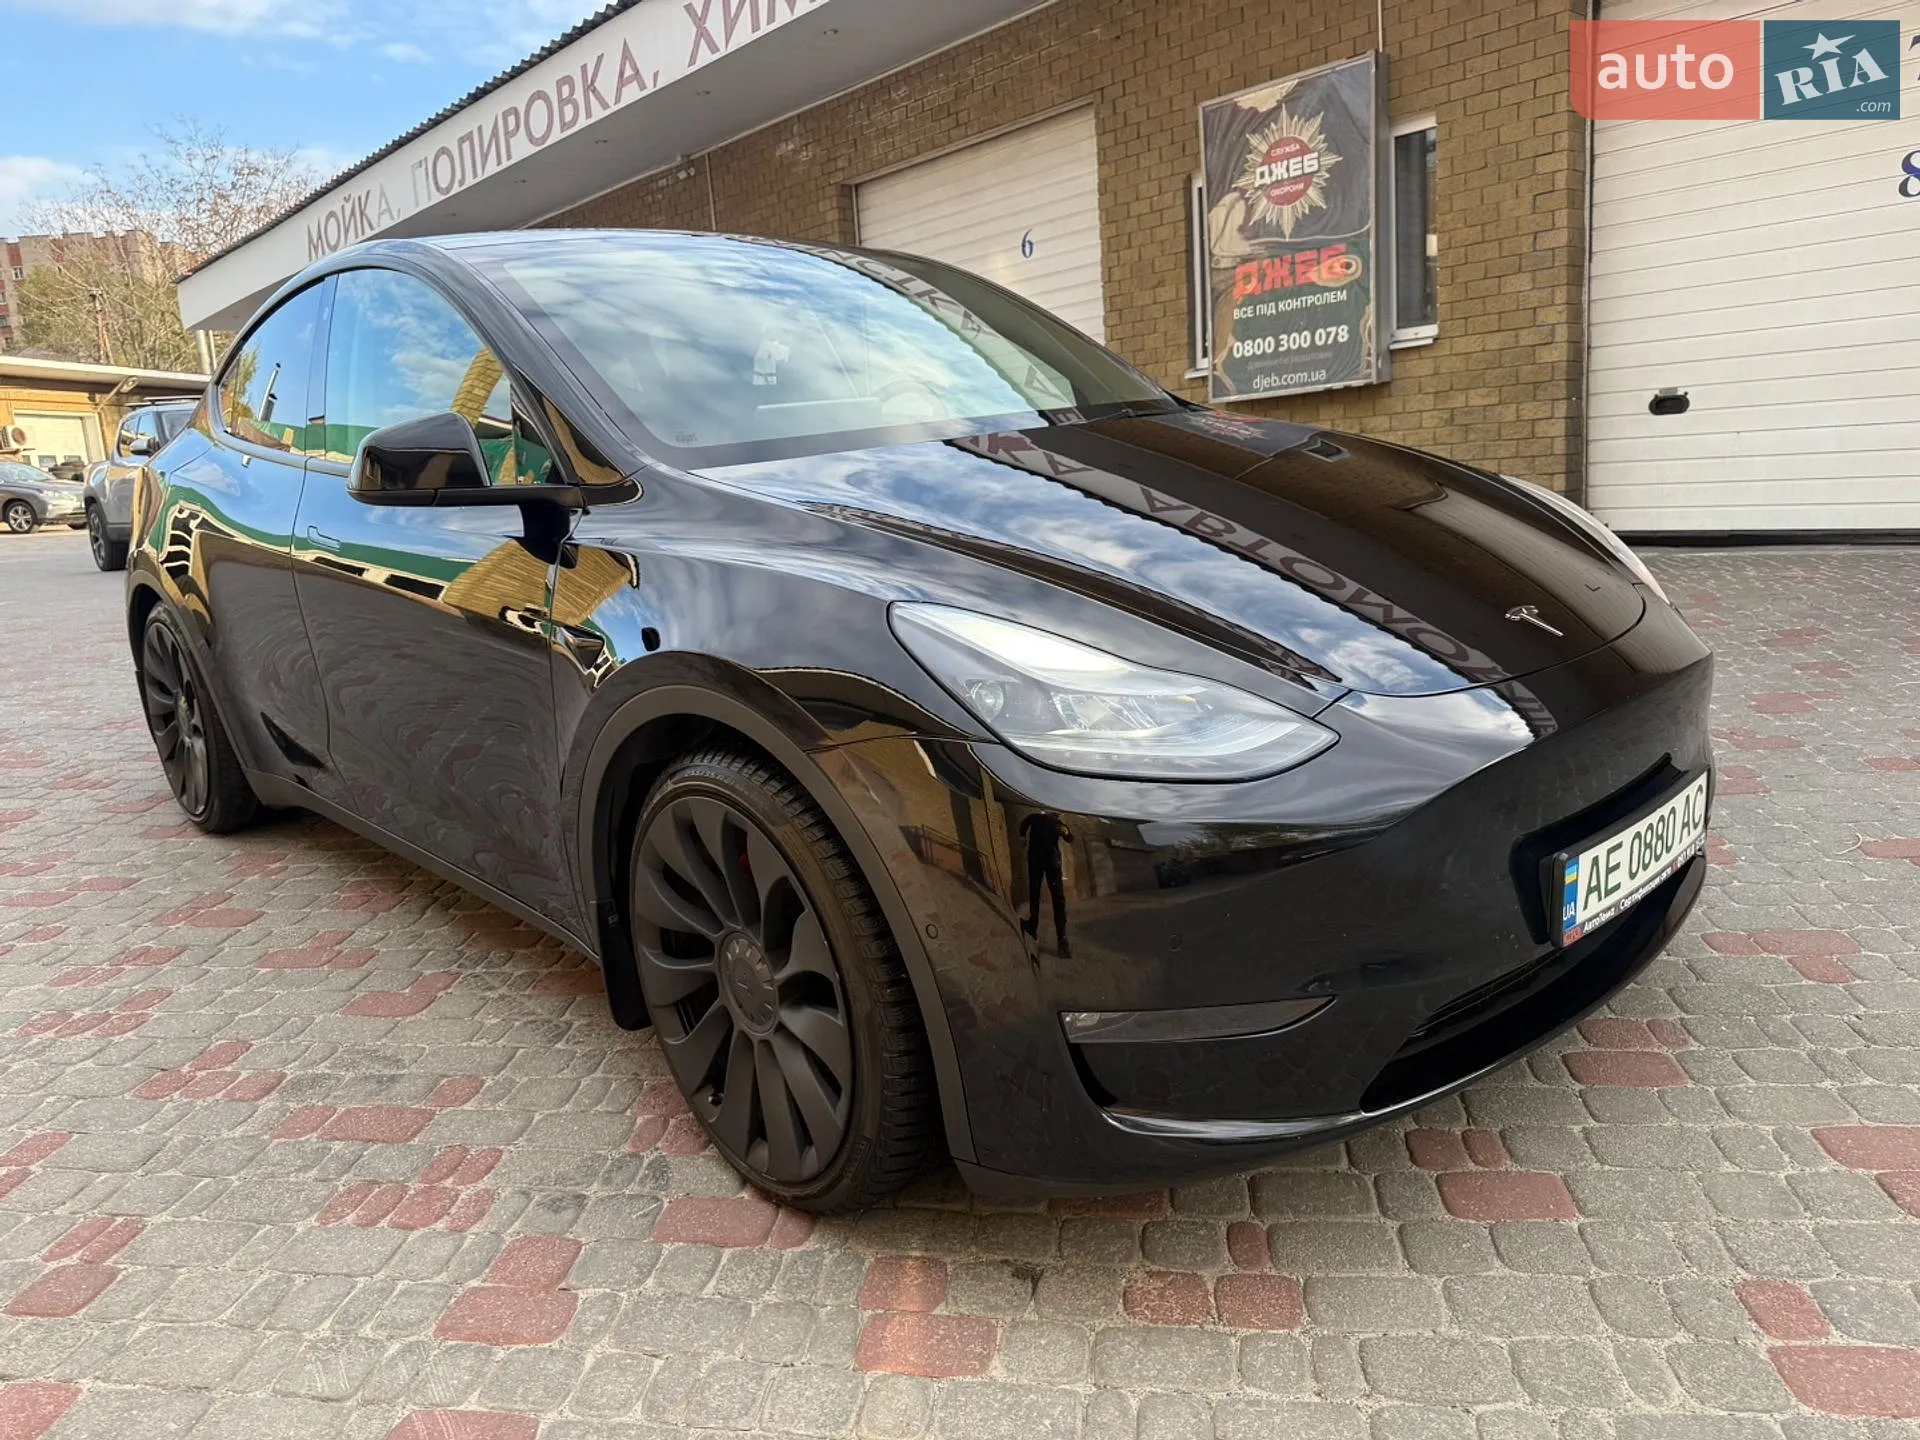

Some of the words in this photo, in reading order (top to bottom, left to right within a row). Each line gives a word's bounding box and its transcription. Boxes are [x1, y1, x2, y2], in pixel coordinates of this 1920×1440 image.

[307, 182, 401, 262] МОЙКА,
[411, 38, 659, 206] ПОЛИРОВКА,
[1254, 151, 1319, 188] ДЖЕБ
[1021, 228, 1034, 259] 6
[1233, 305, 1255, 320] ВСЕ
[1256, 302, 1276, 317] ПІД
[1278, 289, 1348, 313] КОНТРОЛЕМ
[1232, 336, 1276, 359] 0800
[1278, 330, 1312, 352] 300
[1314, 324, 1350, 347] 078
[1252, 369, 1327, 392] djeb.com.ua
[1583, 841, 1623, 911] AE
[1628, 806, 1676, 880] 0880
[1679, 784, 1704, 845] AC
[1562, 902, 1576, 921] UA
